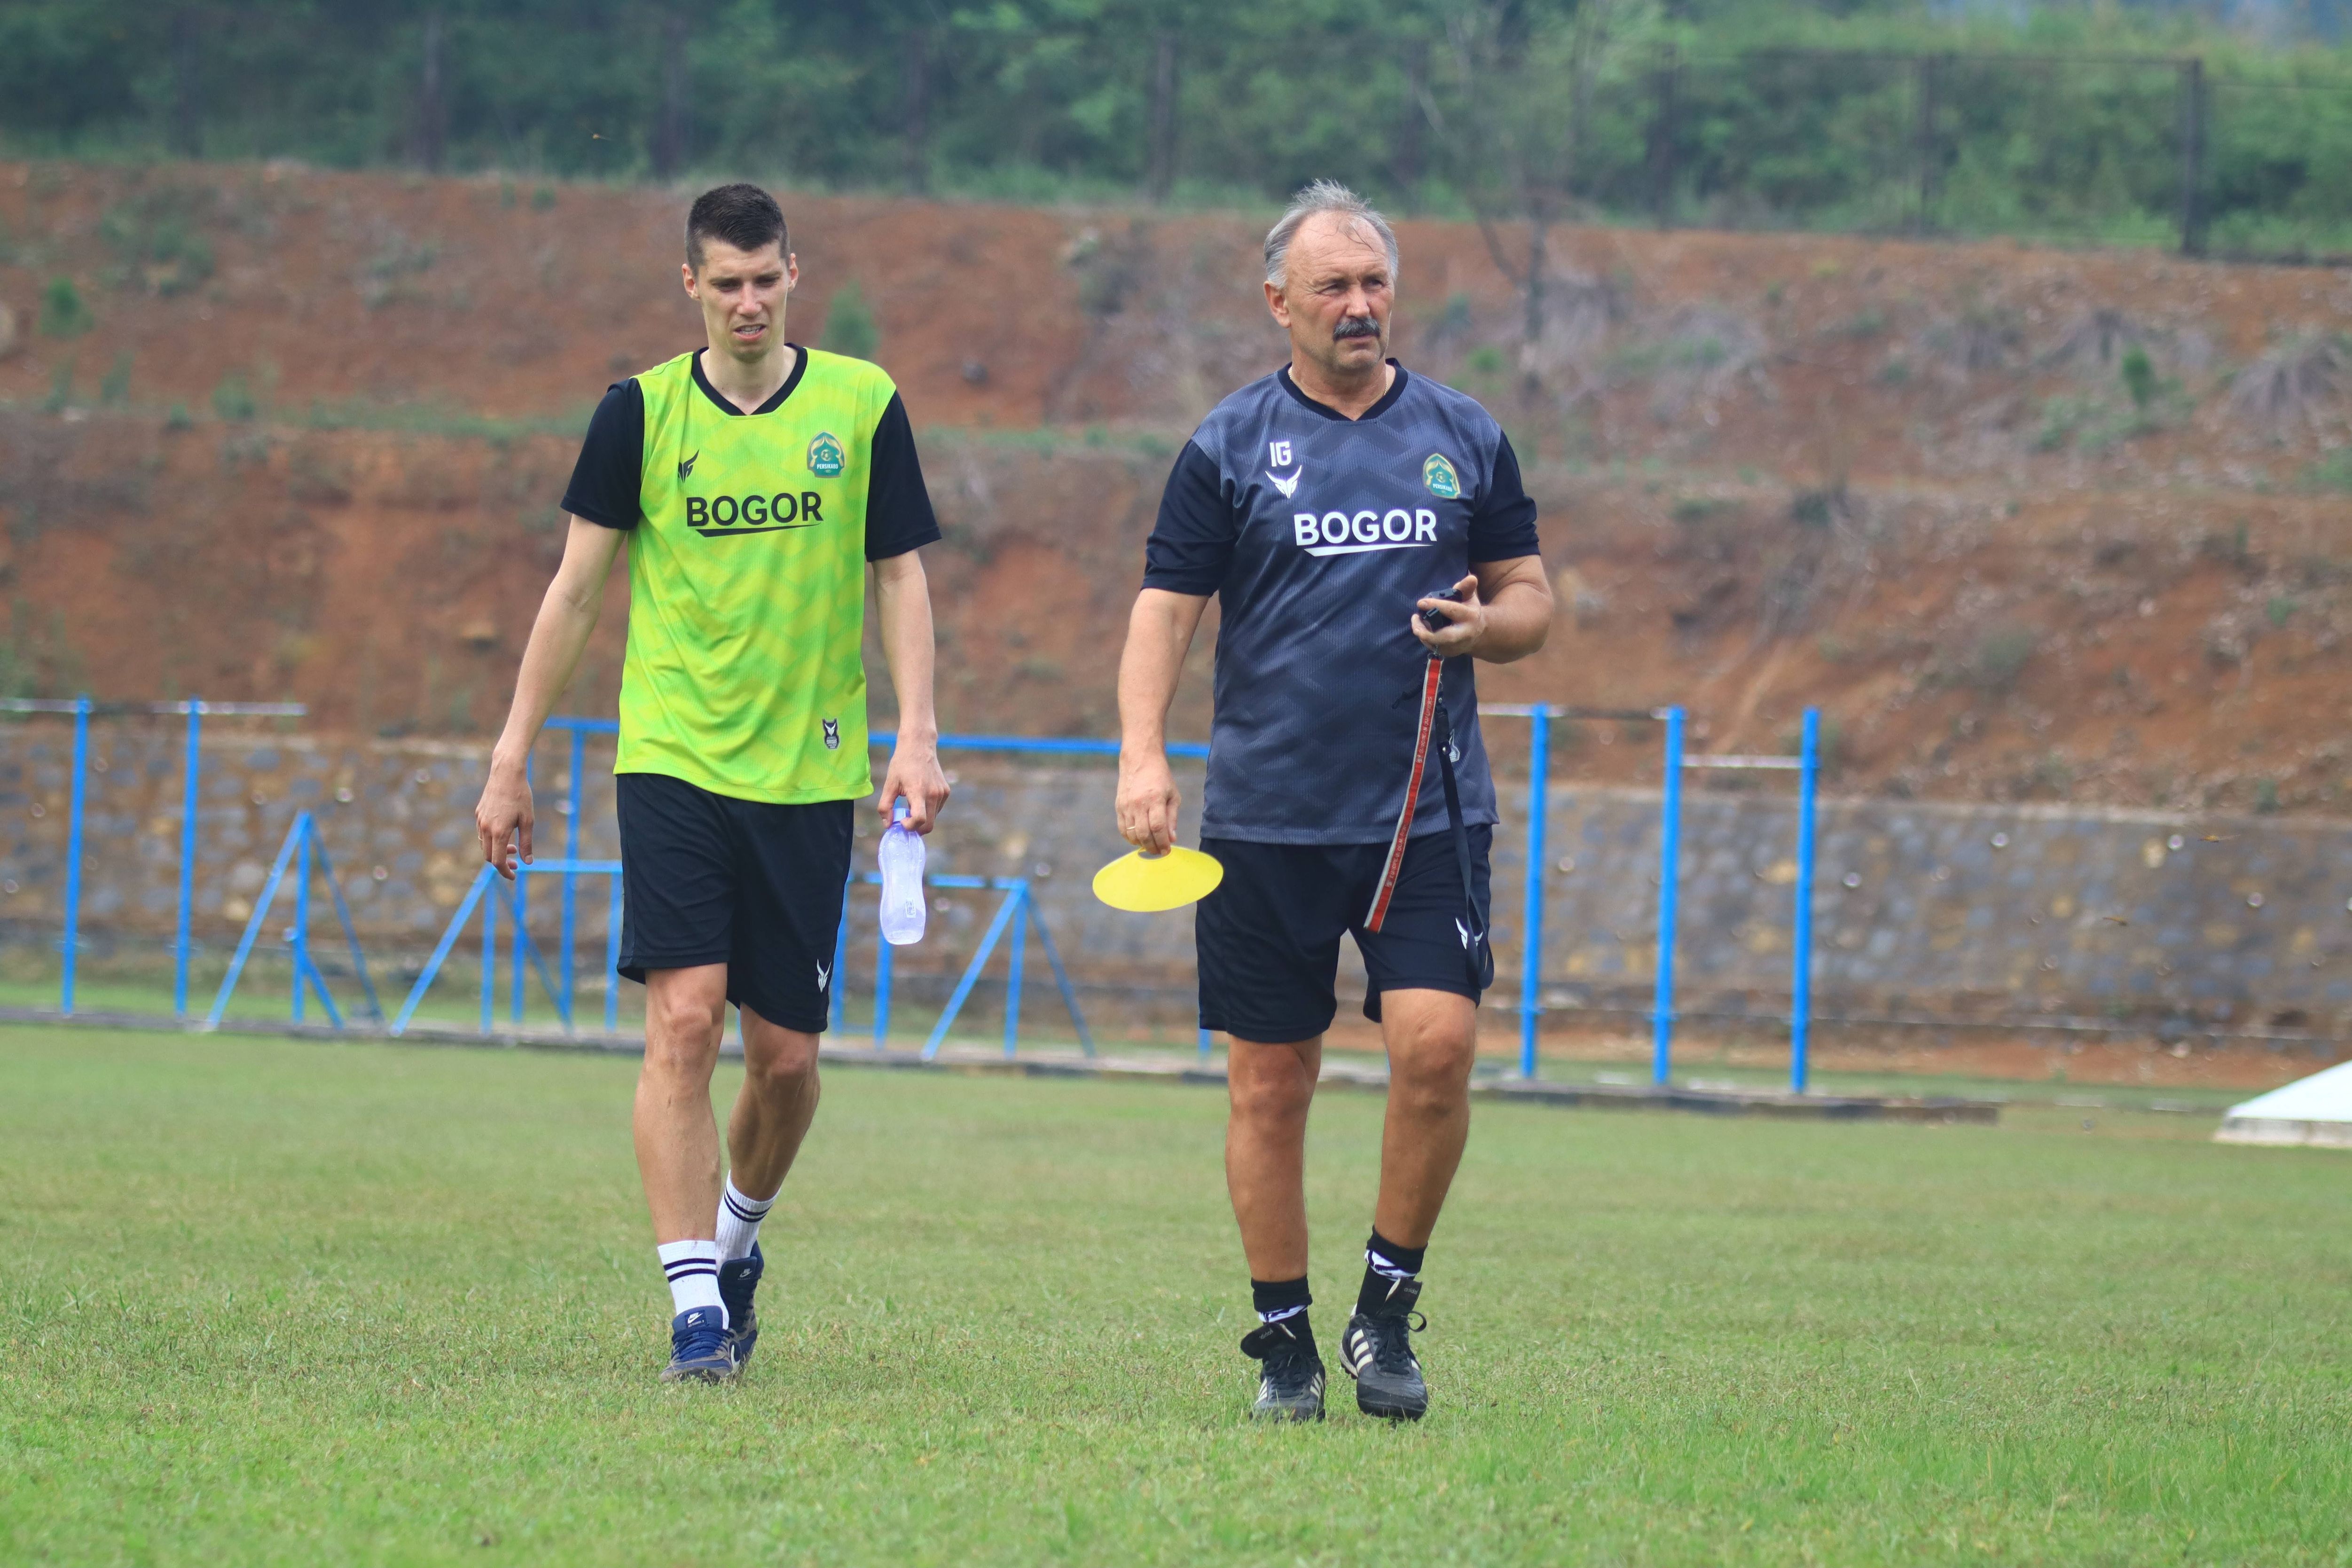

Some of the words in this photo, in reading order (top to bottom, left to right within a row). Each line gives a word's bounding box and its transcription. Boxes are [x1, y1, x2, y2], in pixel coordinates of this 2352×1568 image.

[1270, 441, 1292, 467] IG
[686, 491, 823, 527] BOGOR
[1294, 509, 1437, 546] BOGOR
